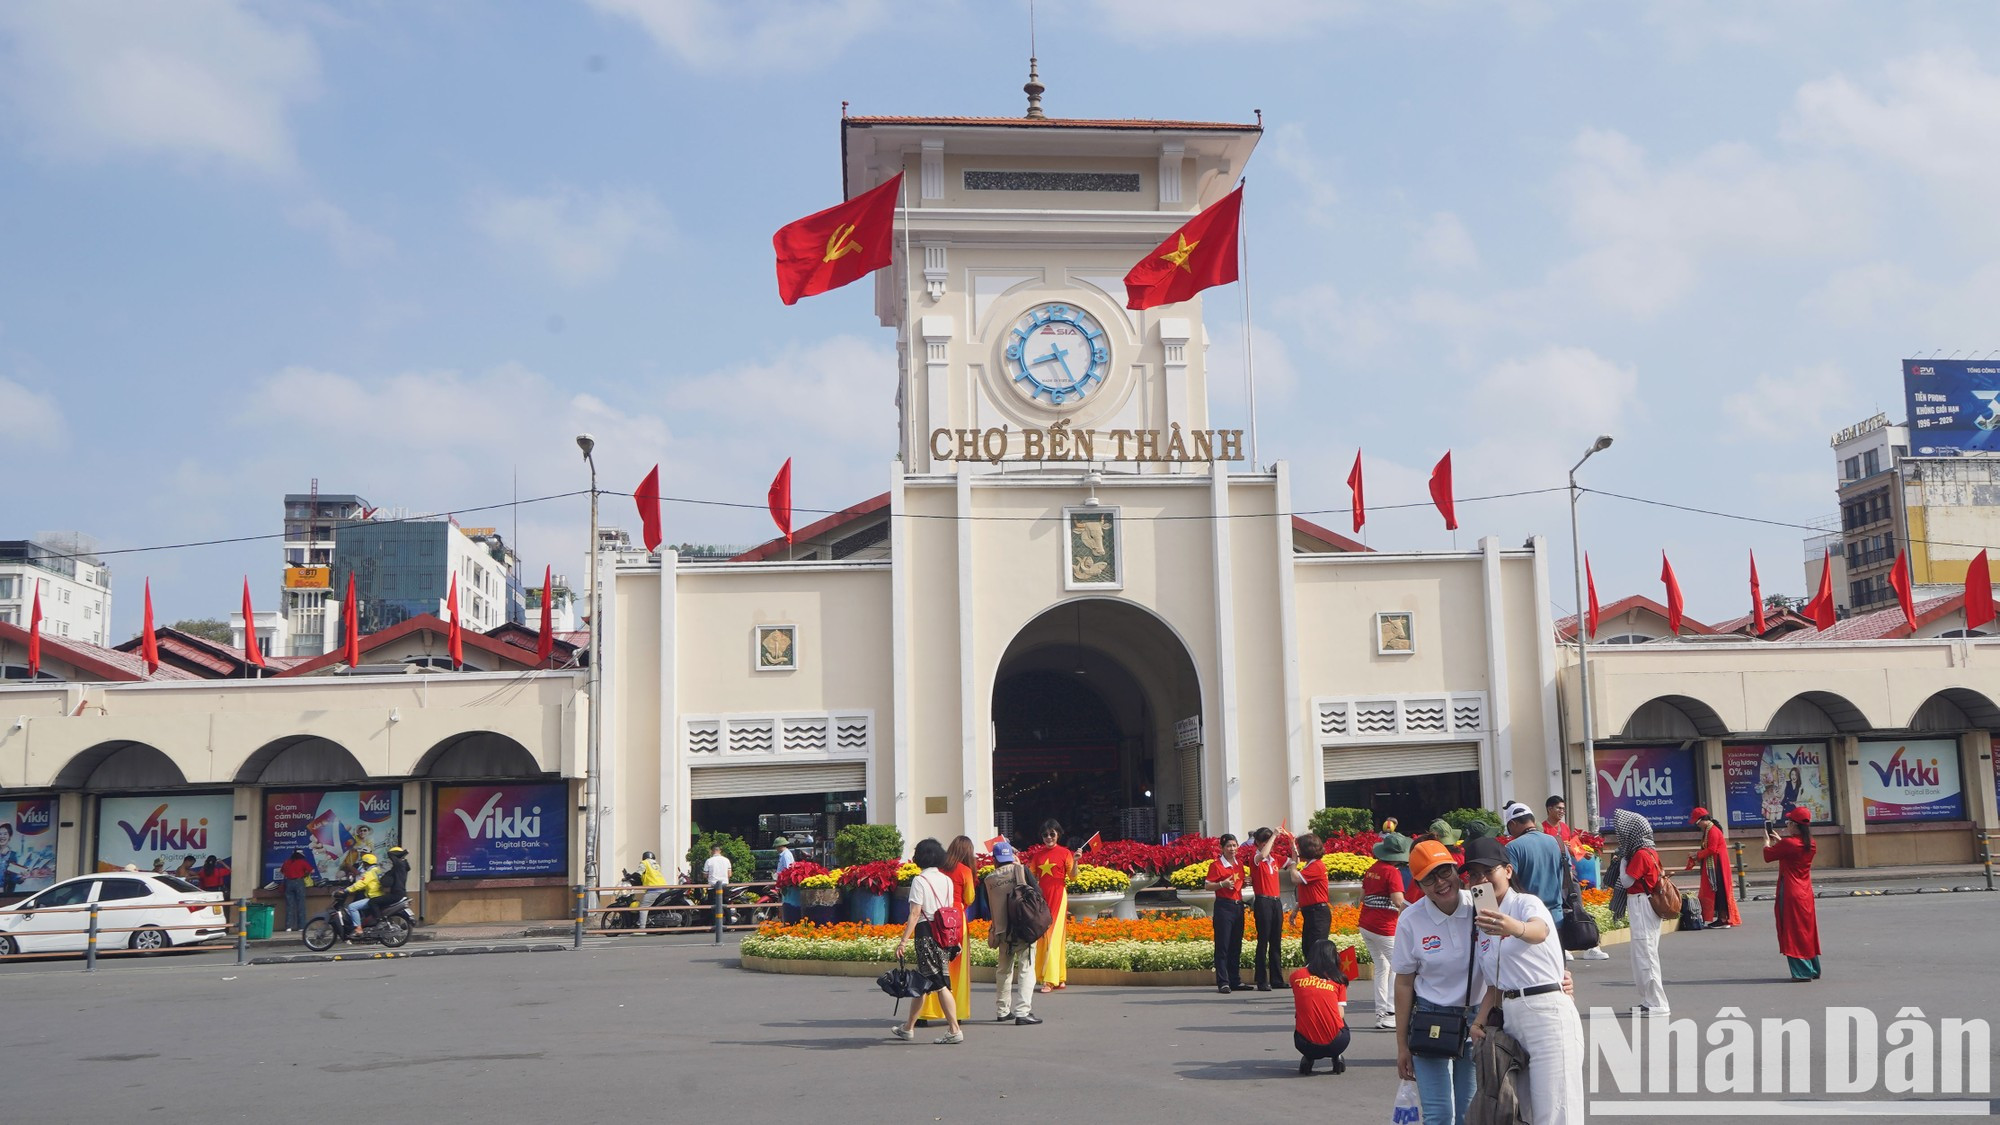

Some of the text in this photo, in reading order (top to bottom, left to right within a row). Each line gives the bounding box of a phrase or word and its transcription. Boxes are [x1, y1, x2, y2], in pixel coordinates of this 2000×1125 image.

[1045, 305, 1069, 320] 12
[1006, 344, 1021, 360] 9
[1094, 347, 1108, 363] 3
[1051, 388, 1064, 404] 6
[1928, 394, 1946, 402] PHONG
[1916, 404, 1935, 415] KHÔNG
[1917, 418, 1931, 429] 1996
[1939, 416, 1953, 425] 2026
[930, 418, 1245, 465] CHỢ BẾN THÀNH
[1786, 745, 1819, 765] Vikki
[1869, 746, 1939, 787] Vikki
[1599, 755, 1673, 797] Vikki
[1905, 788, 1924, 796] Digital
[275, 804, 297, 812] Chạm
[360, 794, 390, 811] Vikki
[1636, 799, 1656, 807] Digital
[18, 807, 48, 823] Vikki
[274, 812, 291, 820] cảm
[454, 792, 541, 839] Vikki
[117, 803, 208, 851] Vikki
[274, 822, 288, 830] Bật
[495, 841, 520, 849] Digital
